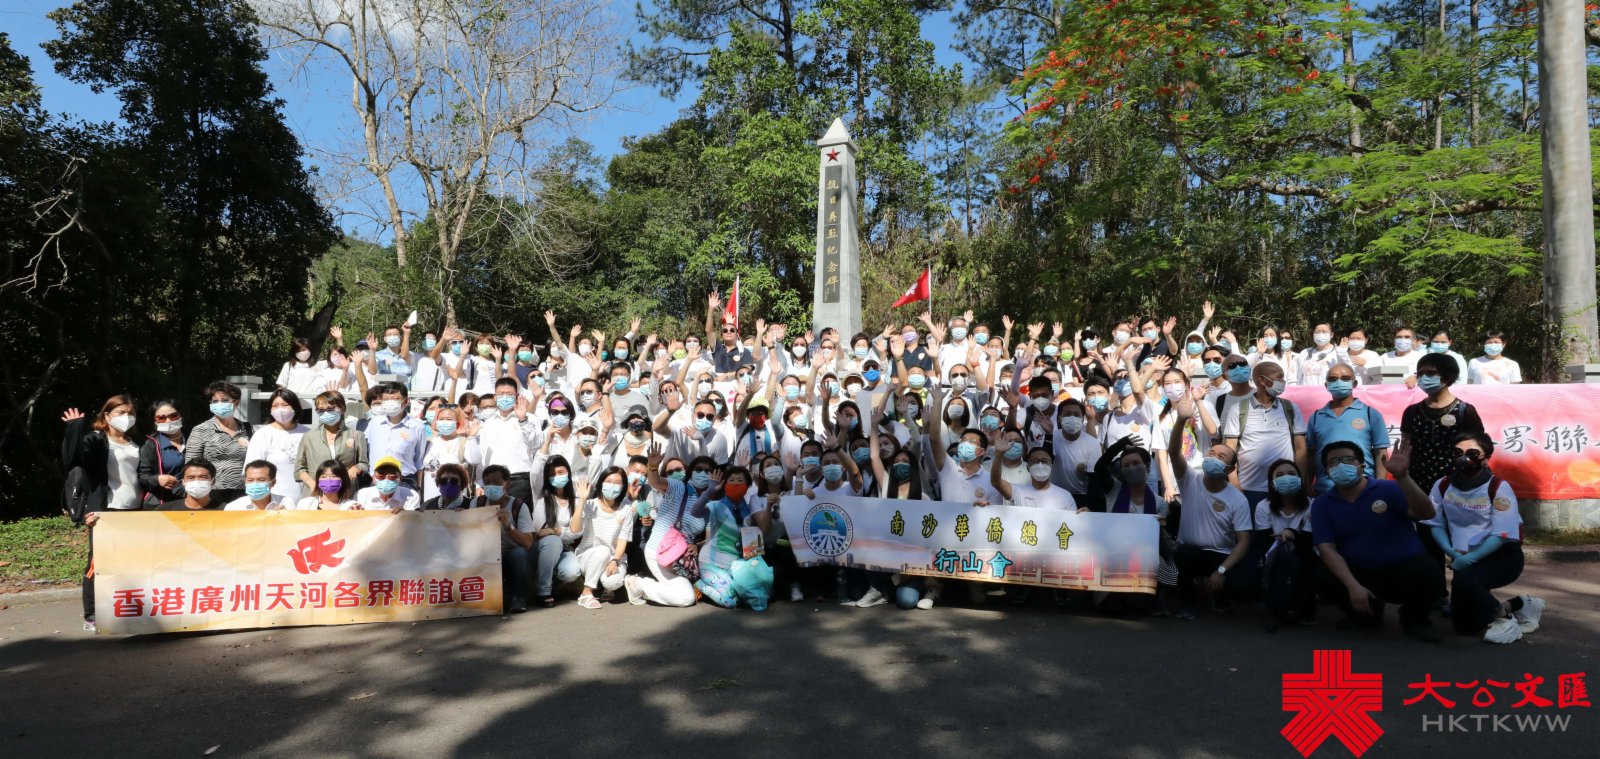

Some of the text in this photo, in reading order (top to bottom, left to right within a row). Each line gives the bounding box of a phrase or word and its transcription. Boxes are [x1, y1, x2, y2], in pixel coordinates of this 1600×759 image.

[890, 511, 1074, 550] 南沙華僑總會
[934, 549, 1013, 579] 行山會
[113, 575, 486, 618] 香港廣州天河各界聯誼會
